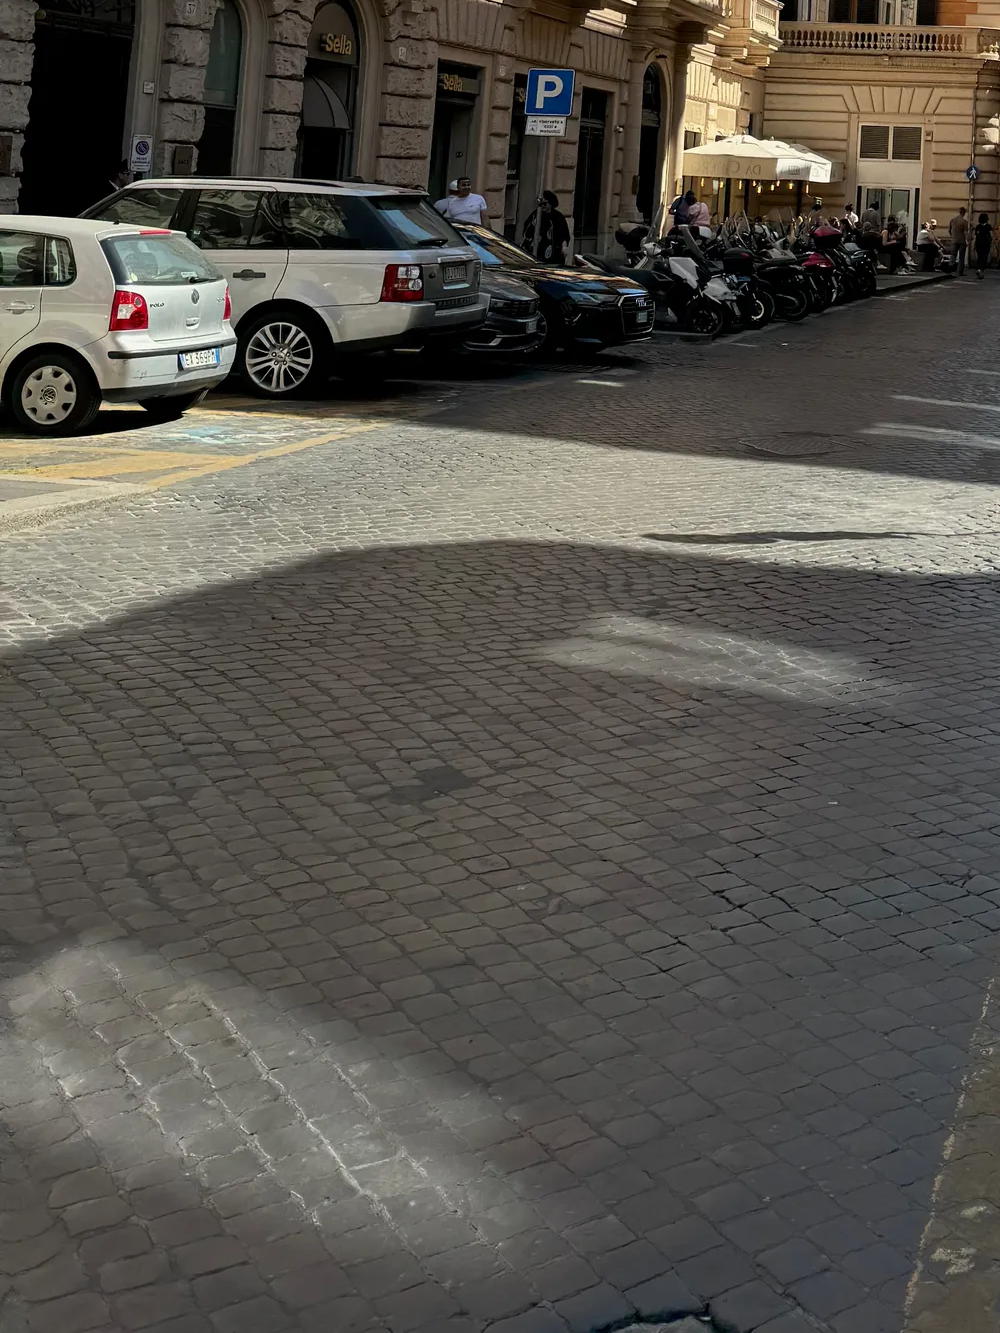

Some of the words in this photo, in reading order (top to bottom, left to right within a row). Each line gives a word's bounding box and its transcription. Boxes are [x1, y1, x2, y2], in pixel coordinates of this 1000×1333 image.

[325, 32, 352, 55] Sella
[443, 73, 464, 92] Sella
[535, 74, 564, 109] P
